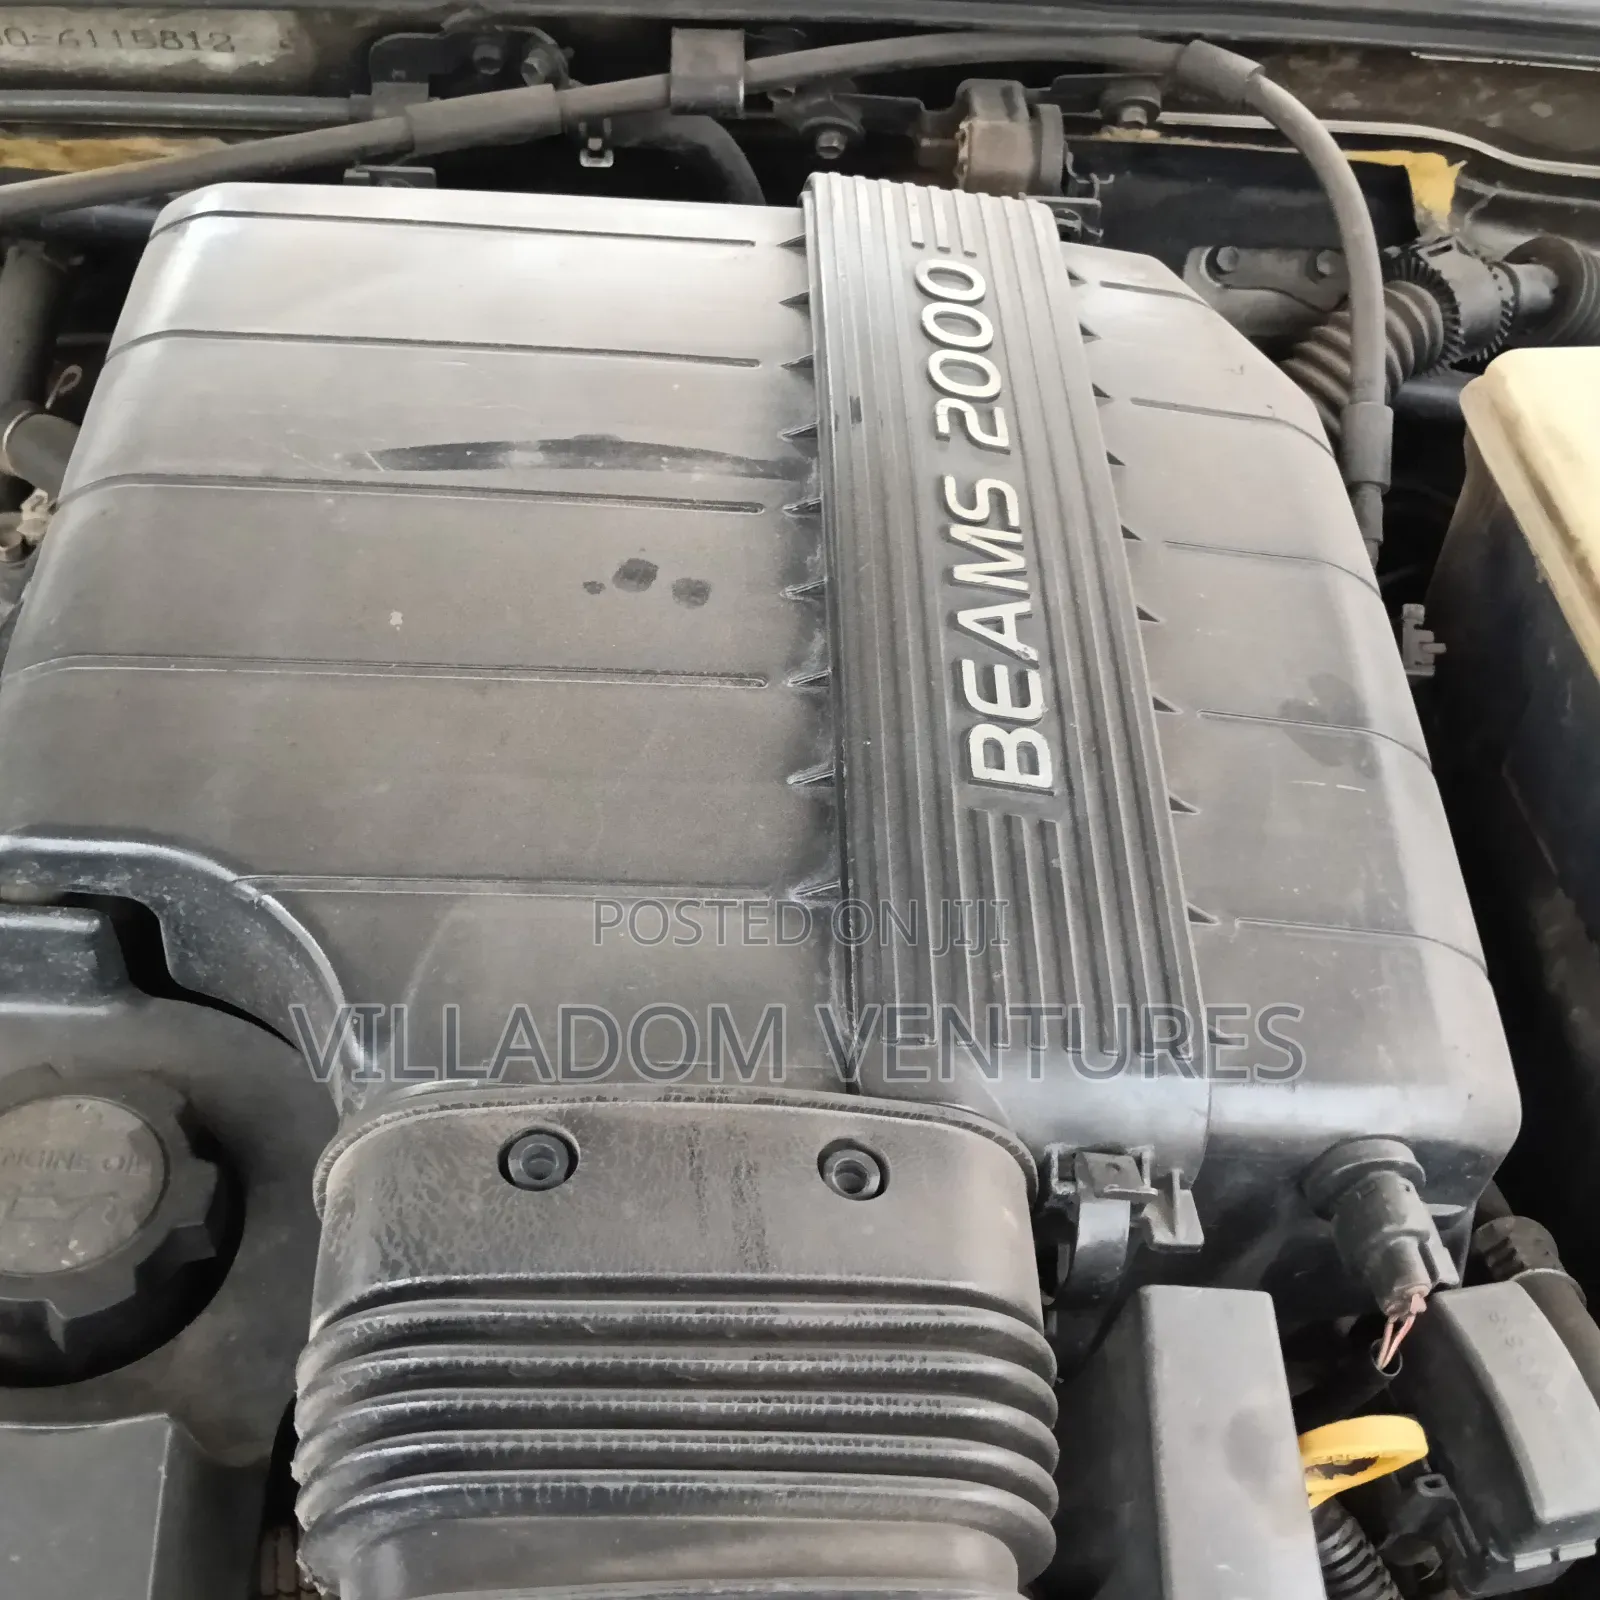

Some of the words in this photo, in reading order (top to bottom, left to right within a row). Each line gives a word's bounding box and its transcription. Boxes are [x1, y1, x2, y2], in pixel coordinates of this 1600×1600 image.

[0, 26, 236, 54] 0-6115812
[914, 258, 1011, 453] 2000
[944, 475, 1055, 792] BEAMS
